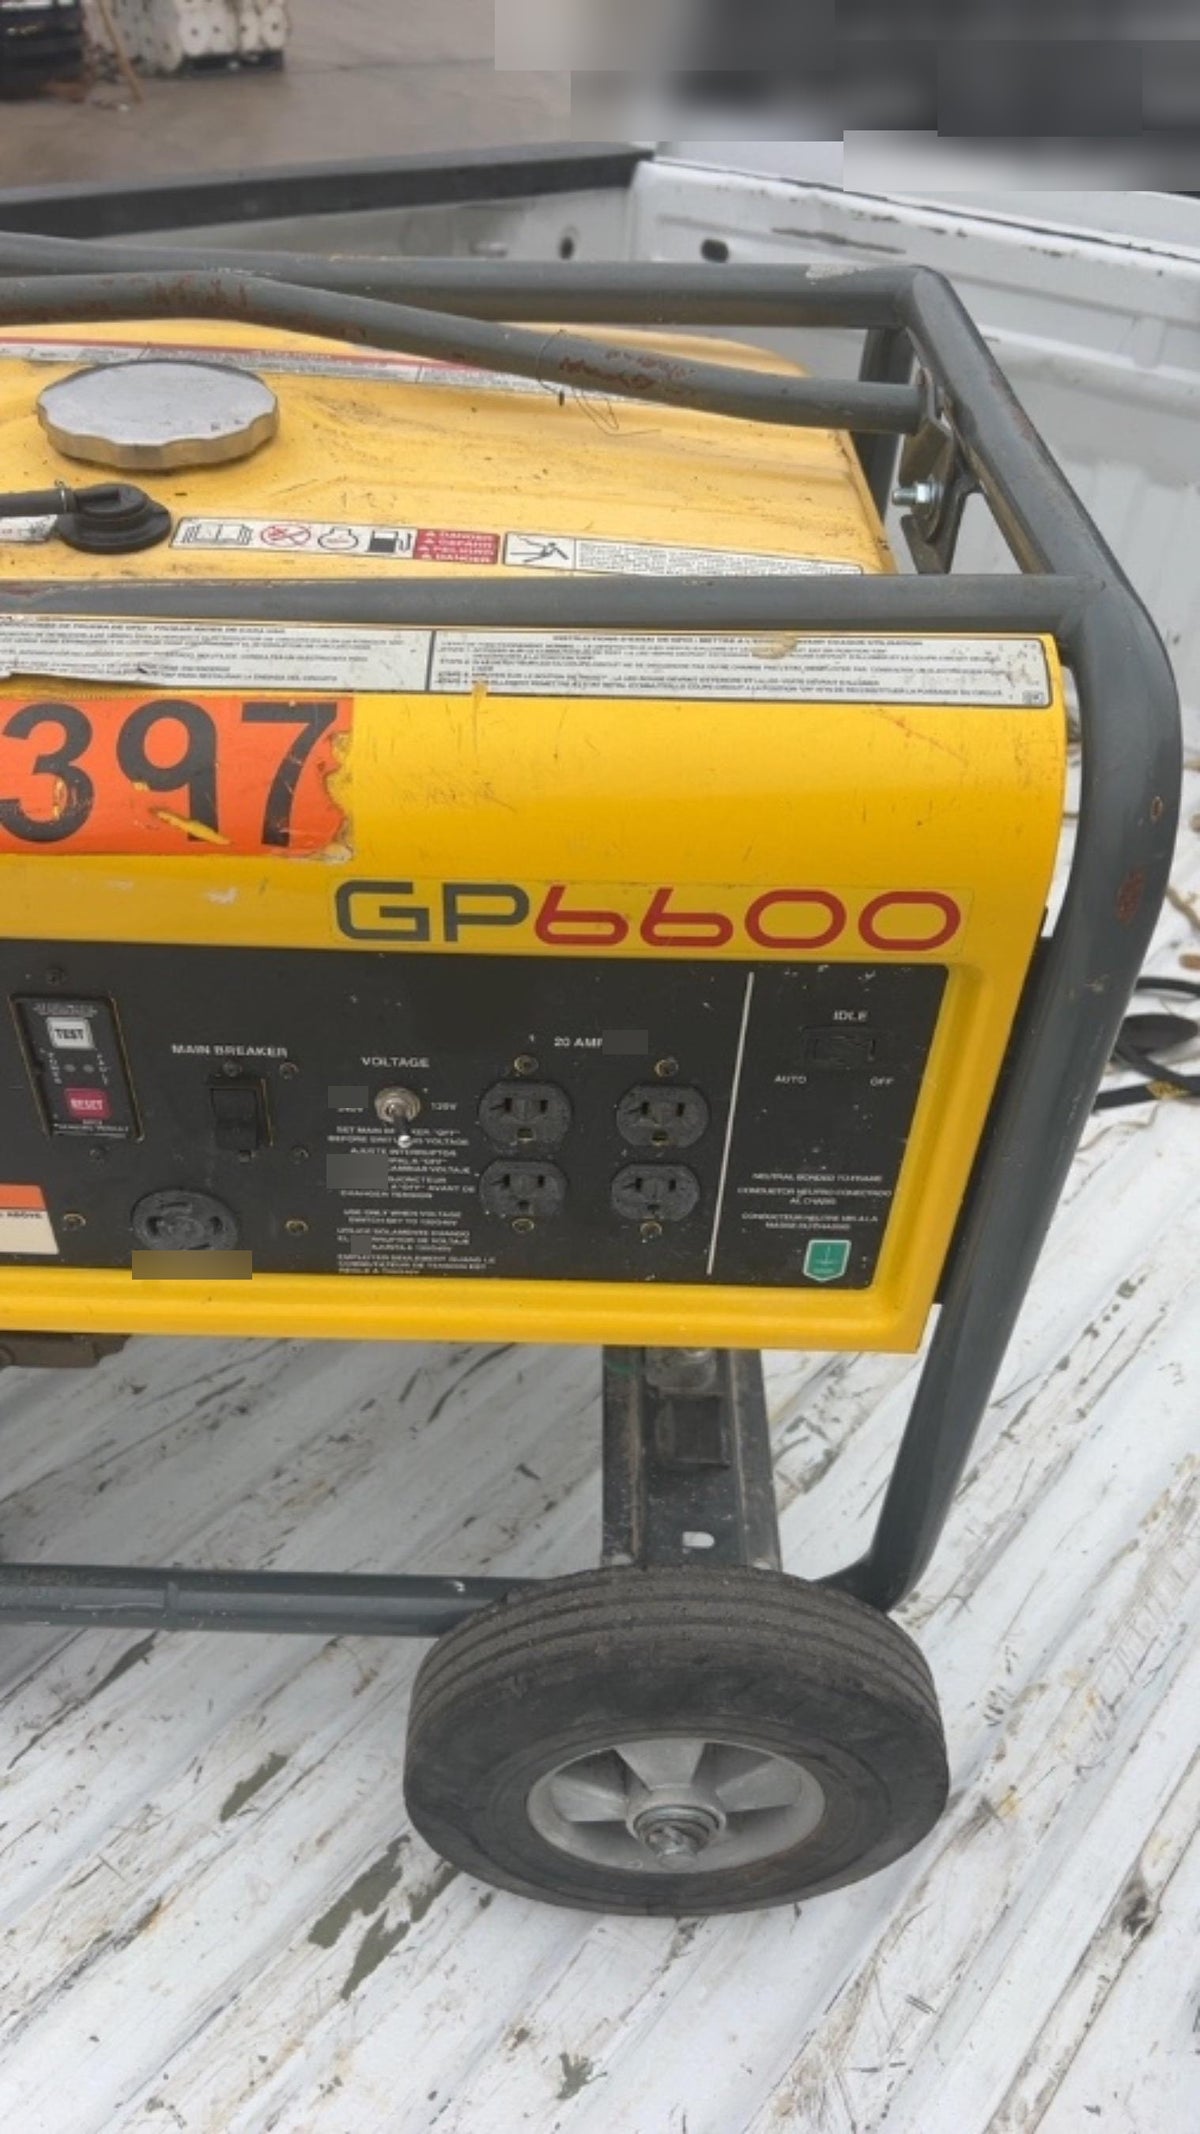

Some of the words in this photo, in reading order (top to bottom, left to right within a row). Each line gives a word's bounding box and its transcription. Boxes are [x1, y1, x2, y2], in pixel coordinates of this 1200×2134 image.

[0, 699, 338, 848] 397
[335, 879, 961, 950] GP6600
[833, 1010, 869, 1022] IDLE
[54, 1028, 84, 1040] TEST
[553, 1037, 570, 1047] 20
[172, 1044, 210, 1055] MAIN
[214, 1045, 288, 1058] BREAKER
[361, 1056, 431, 1068] VOLTAGE
[774, 1074, 808, 1085] AUTO
[870, 1076, 895, 1087] OFF
[70, 1098, 104, 1111] RESET
[336, 1125, 354, 1135] SET
